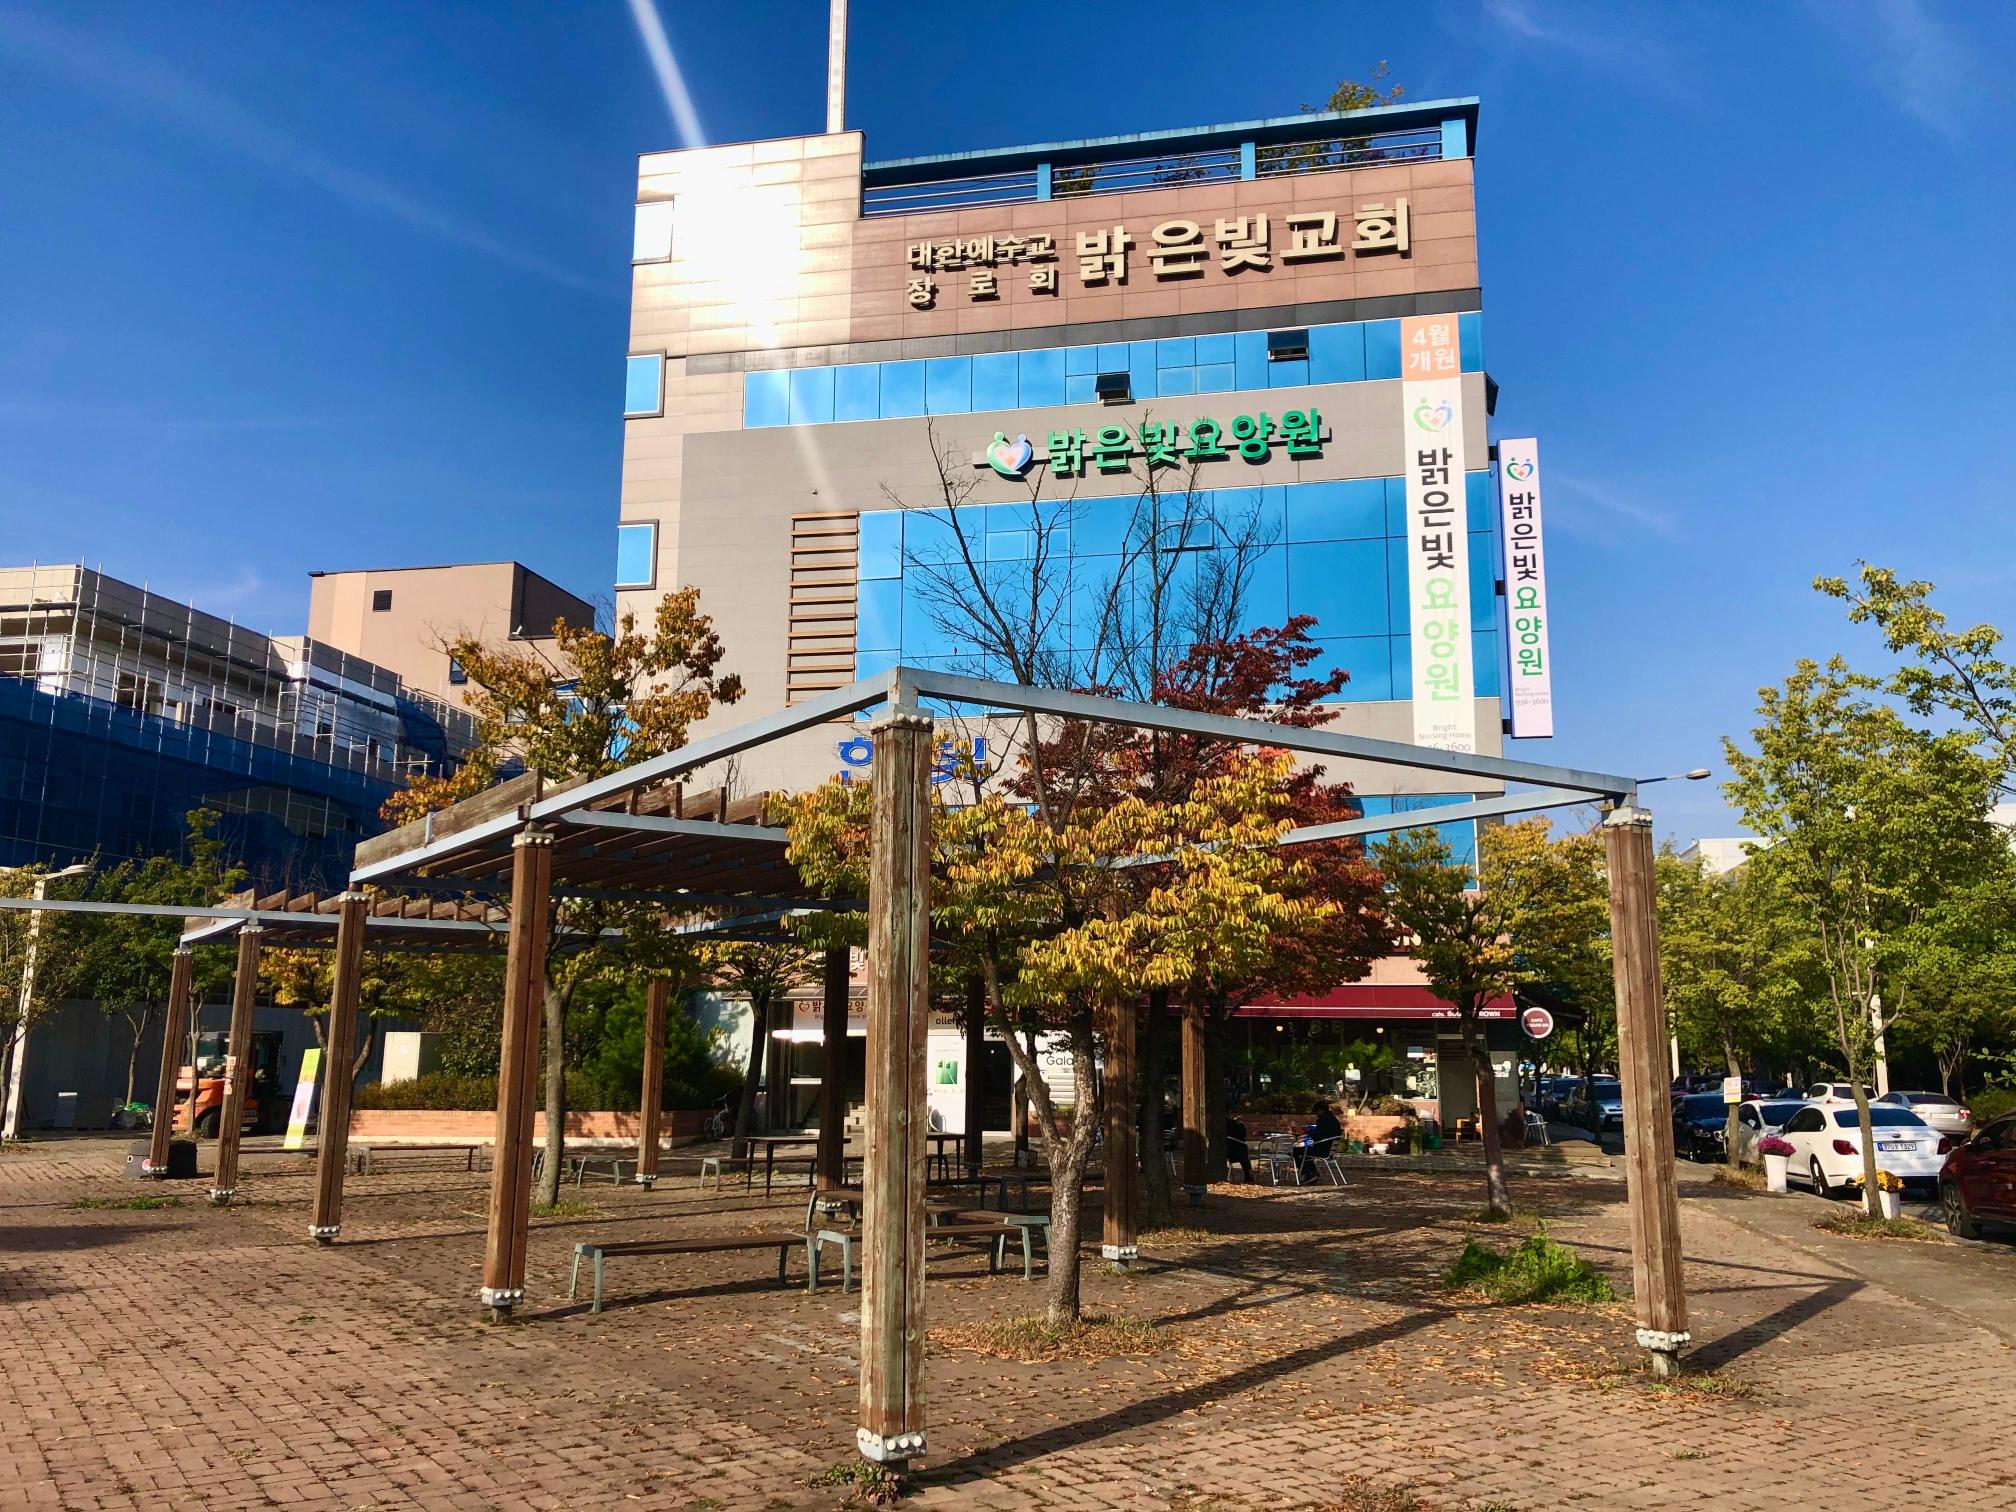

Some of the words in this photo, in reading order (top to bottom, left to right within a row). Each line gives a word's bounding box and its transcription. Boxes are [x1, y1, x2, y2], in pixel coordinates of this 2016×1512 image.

[906, 232, 1057, 270] 대한예수교
[1075, 197, 1411, 282] 밝은빛교회
[1412, 323, 1450, 347] 4월
[1409, 347, 1456, 373] 개원
[1046, 407, 1323, 474] 밝은빛요양원
[1432, 724, 1457, 733] Bright
[1046, 1055, 1074, 1066] Gala
